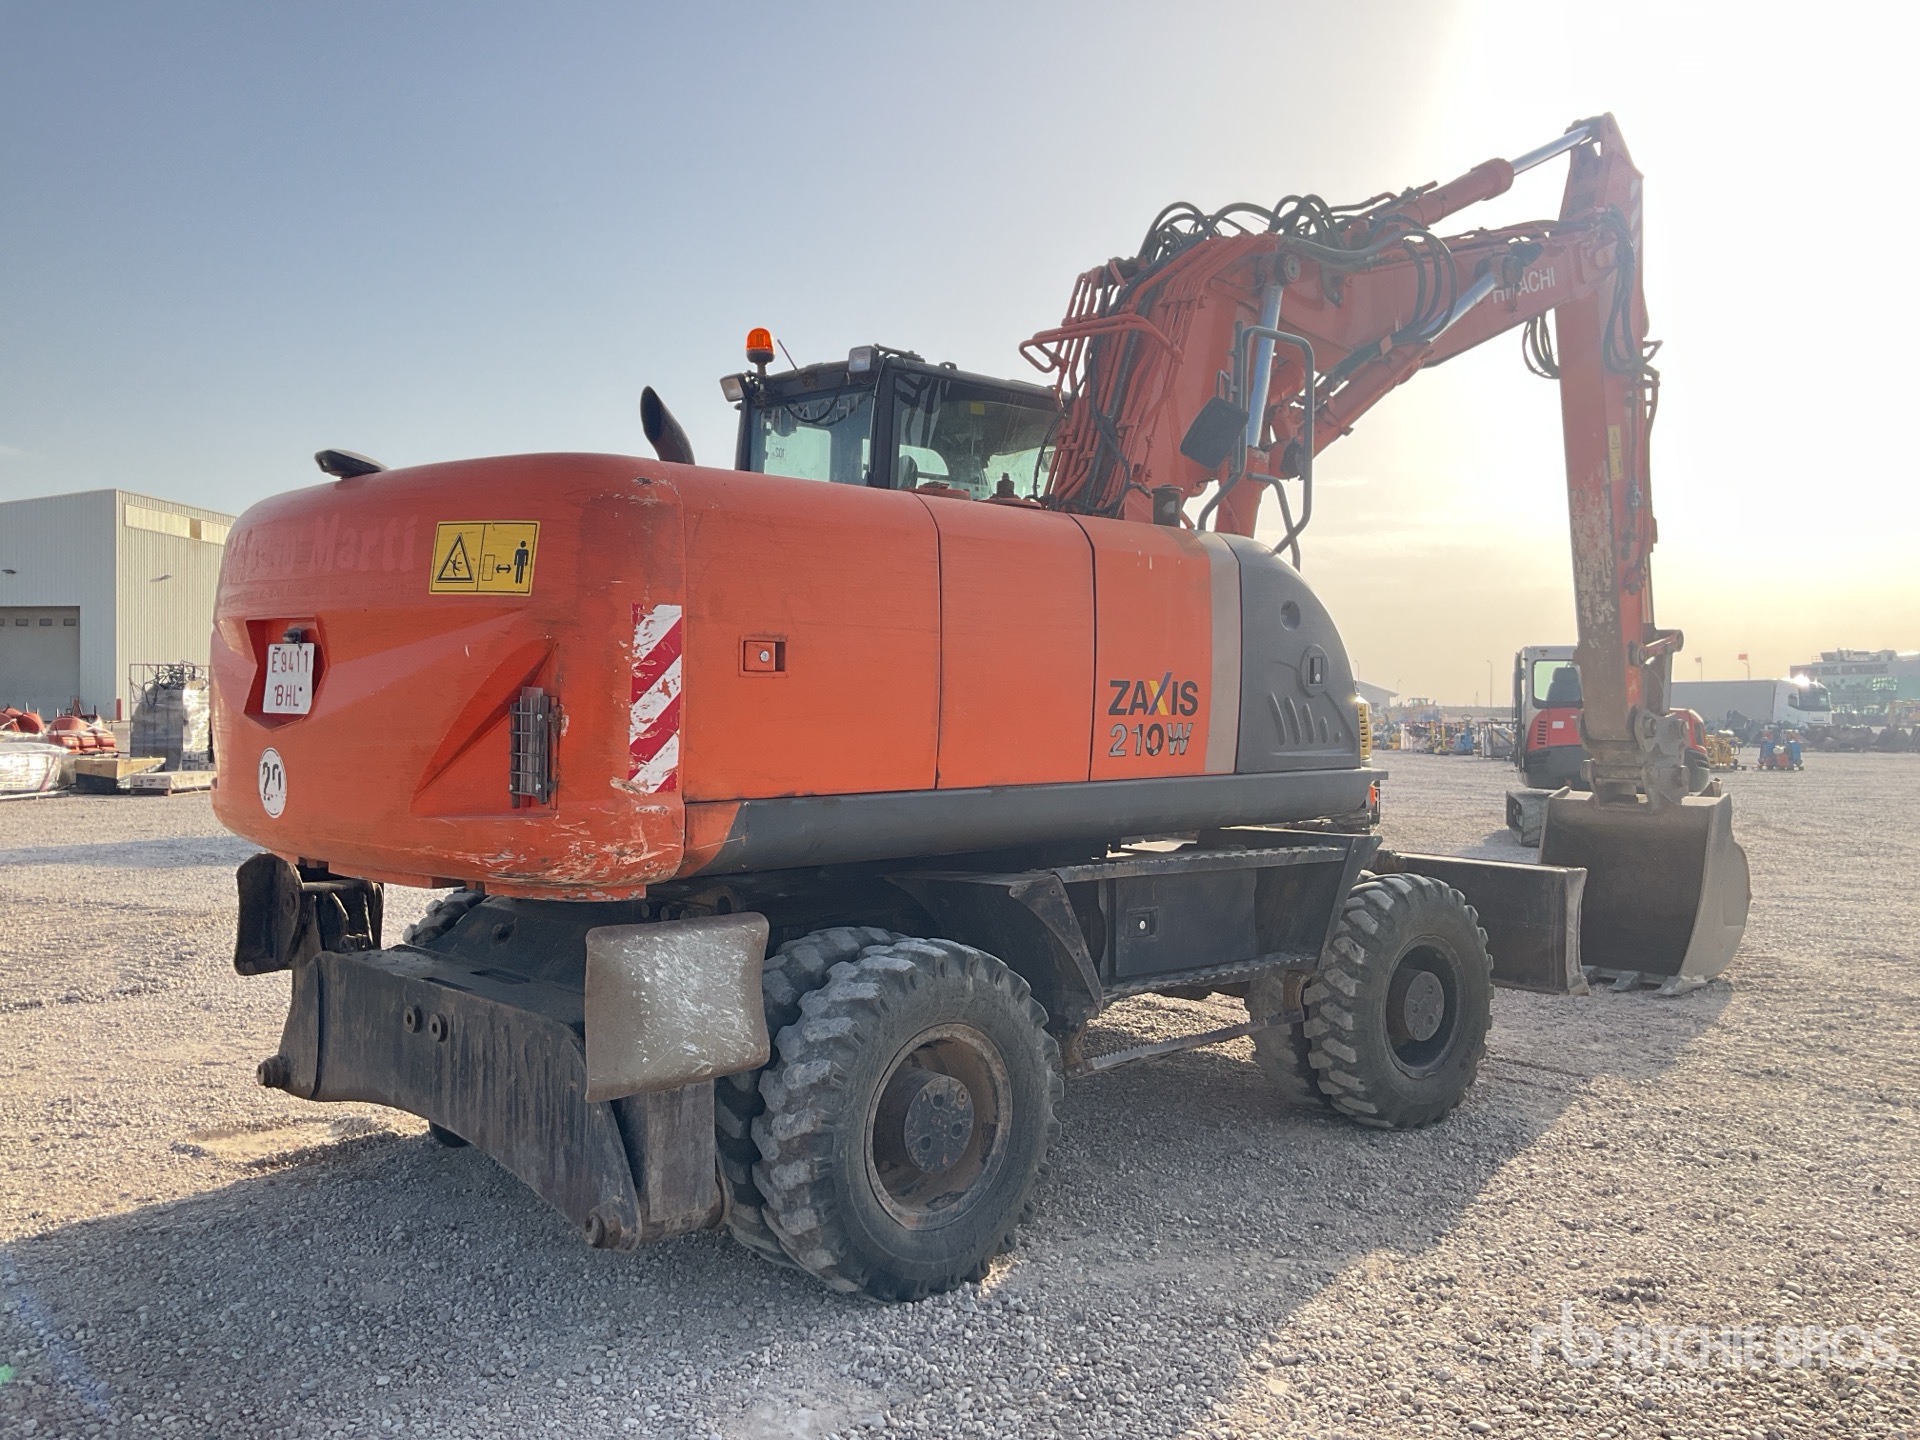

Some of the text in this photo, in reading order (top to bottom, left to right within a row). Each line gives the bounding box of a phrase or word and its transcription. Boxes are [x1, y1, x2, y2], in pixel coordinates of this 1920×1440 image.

[1492, 267, 1556, 304] HIACHI
[271, 650, 309, 673] E9411
[275, 684, 299, 707] BHL
[1108, 671, 1198, 716] ZAXIS
[1108, 722, 1193, 757] 210W
